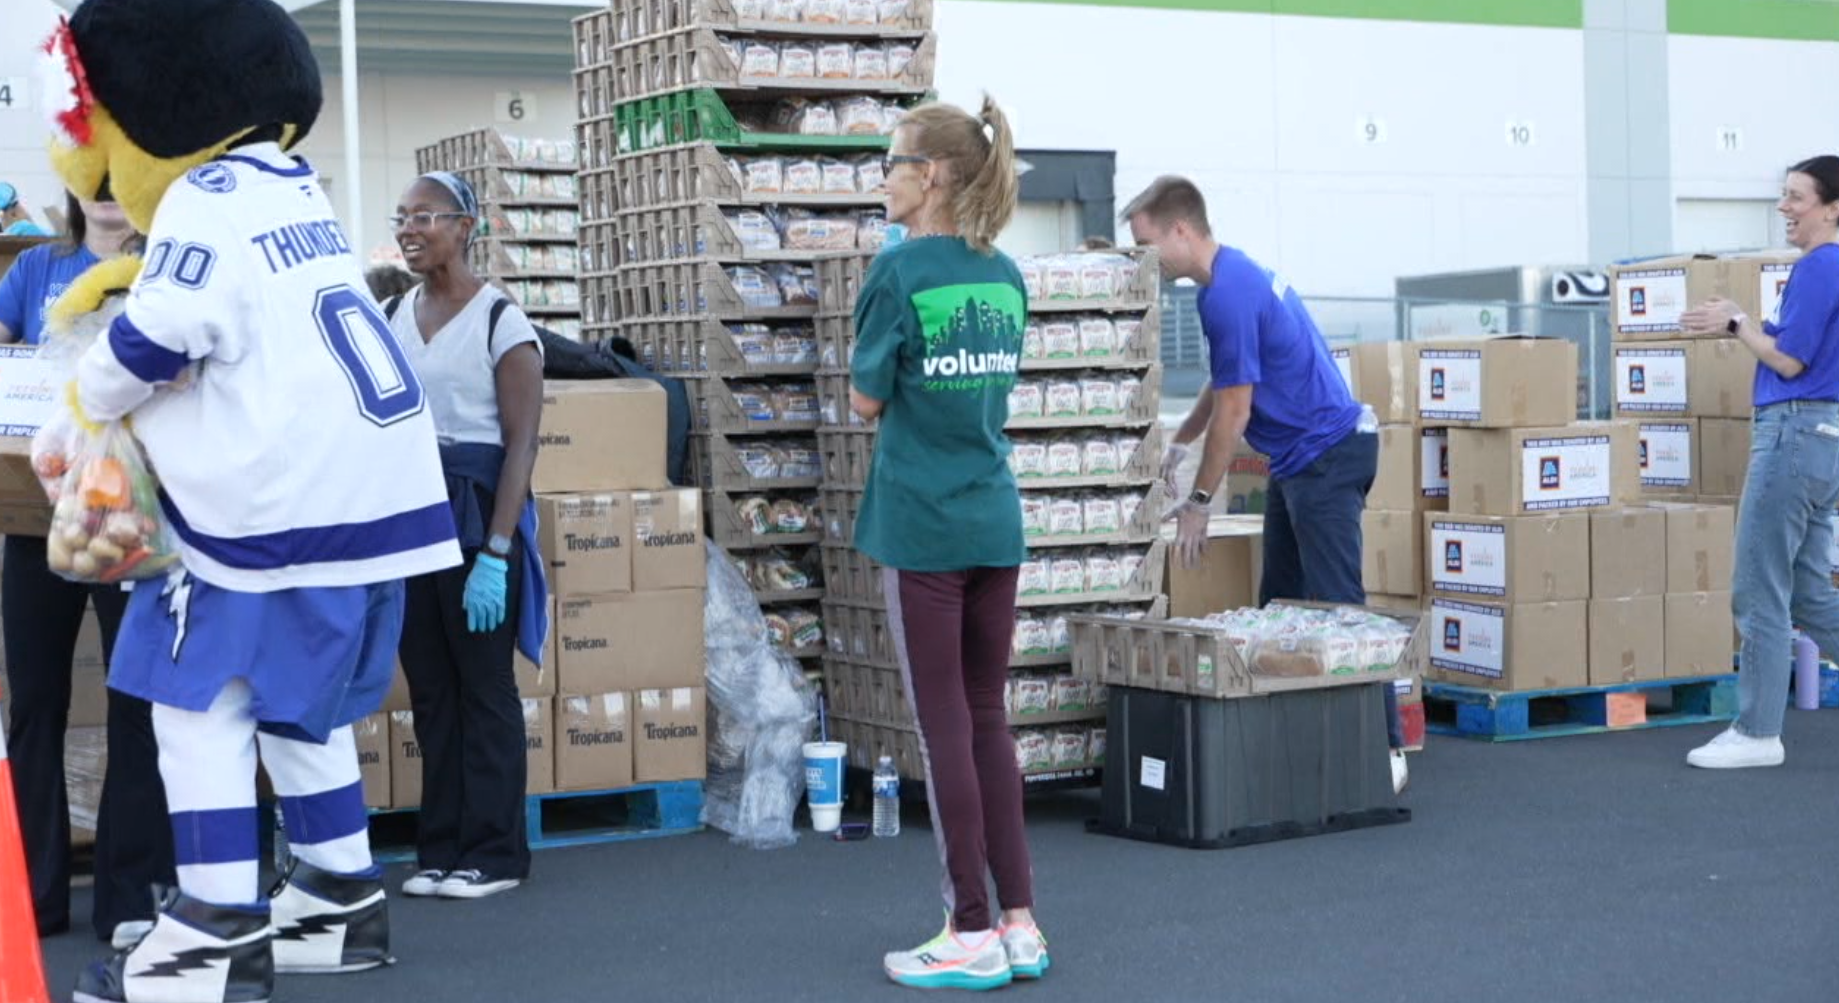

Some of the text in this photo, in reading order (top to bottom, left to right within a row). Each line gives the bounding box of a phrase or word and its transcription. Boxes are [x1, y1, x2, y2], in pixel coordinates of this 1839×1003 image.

[0, 84, 15, 107] 4
[508, 98, 525, 121] 6
[1365, 122, 1377, 142] 9
[1510, 126, 1530, 146] 10
[1722, 131, 1736, 150] 11
[250, 219, 351, 273] THUNDE
[312, 283, 425, 428] 0
[922, 347, 1018, 377] voluntee
[538, 432, 571, 447] picana
[564, 530, 621, 551] Tropicana
[641, 529, 695, 548] Tropicana
[562, 635, 607, 651] Tropicana
[567, 729, 623, 747] Tropicana
[644, 721, 698, 741] Tropicana
